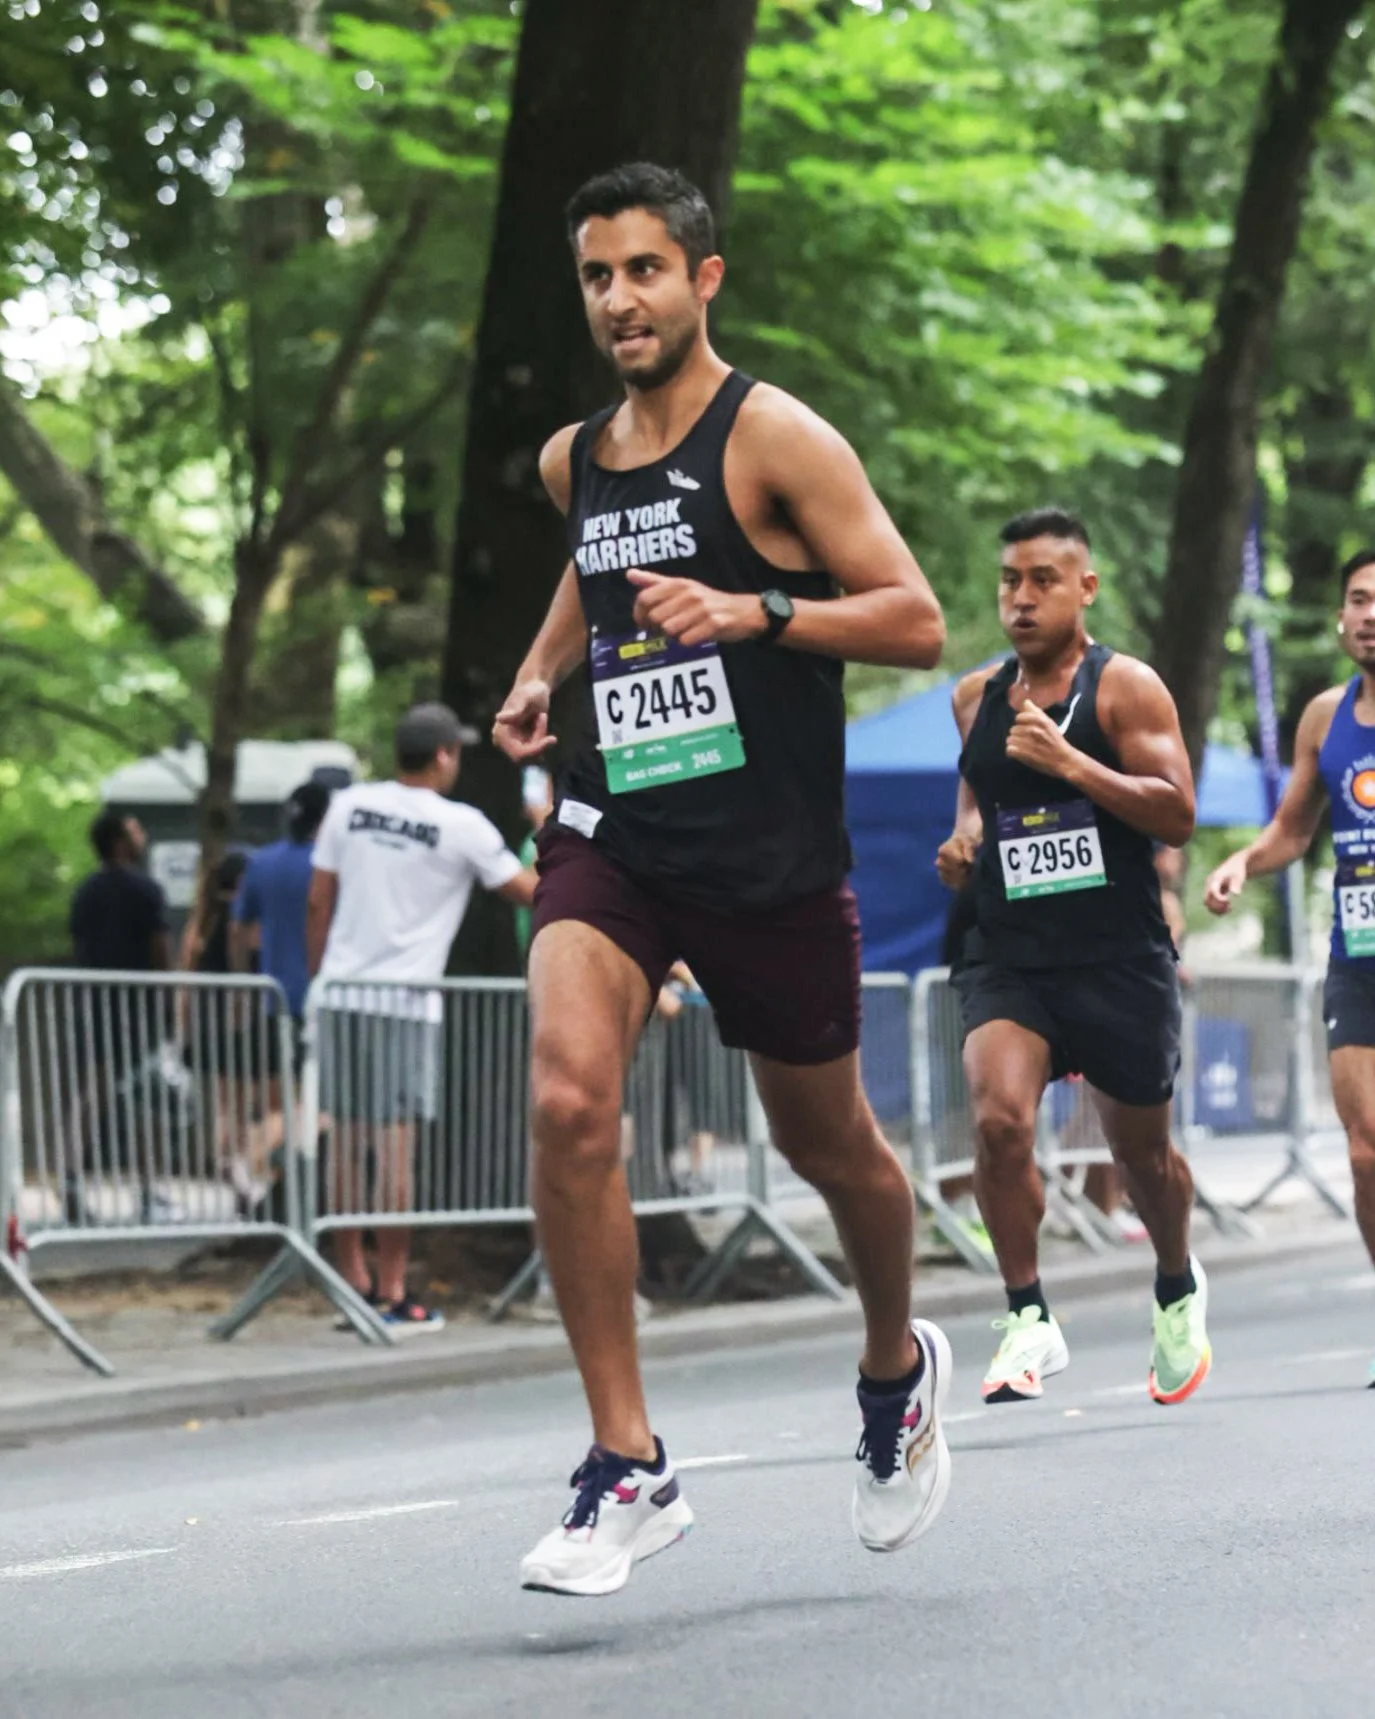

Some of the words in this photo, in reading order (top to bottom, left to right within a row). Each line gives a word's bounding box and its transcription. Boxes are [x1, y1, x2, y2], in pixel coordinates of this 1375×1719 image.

[582, 511, 622, 543] NEW
[625, 498, 682, 532] YORK
[575, 523, 697, 576] HARRIERS
[606, 689, 624, 725] C
[629, 668, 717, 730] 2445
[1008, 847, 1021, 871] C
[1028, 835, 1093, 875] 2956
[1345, 893, 1354, 914] C
